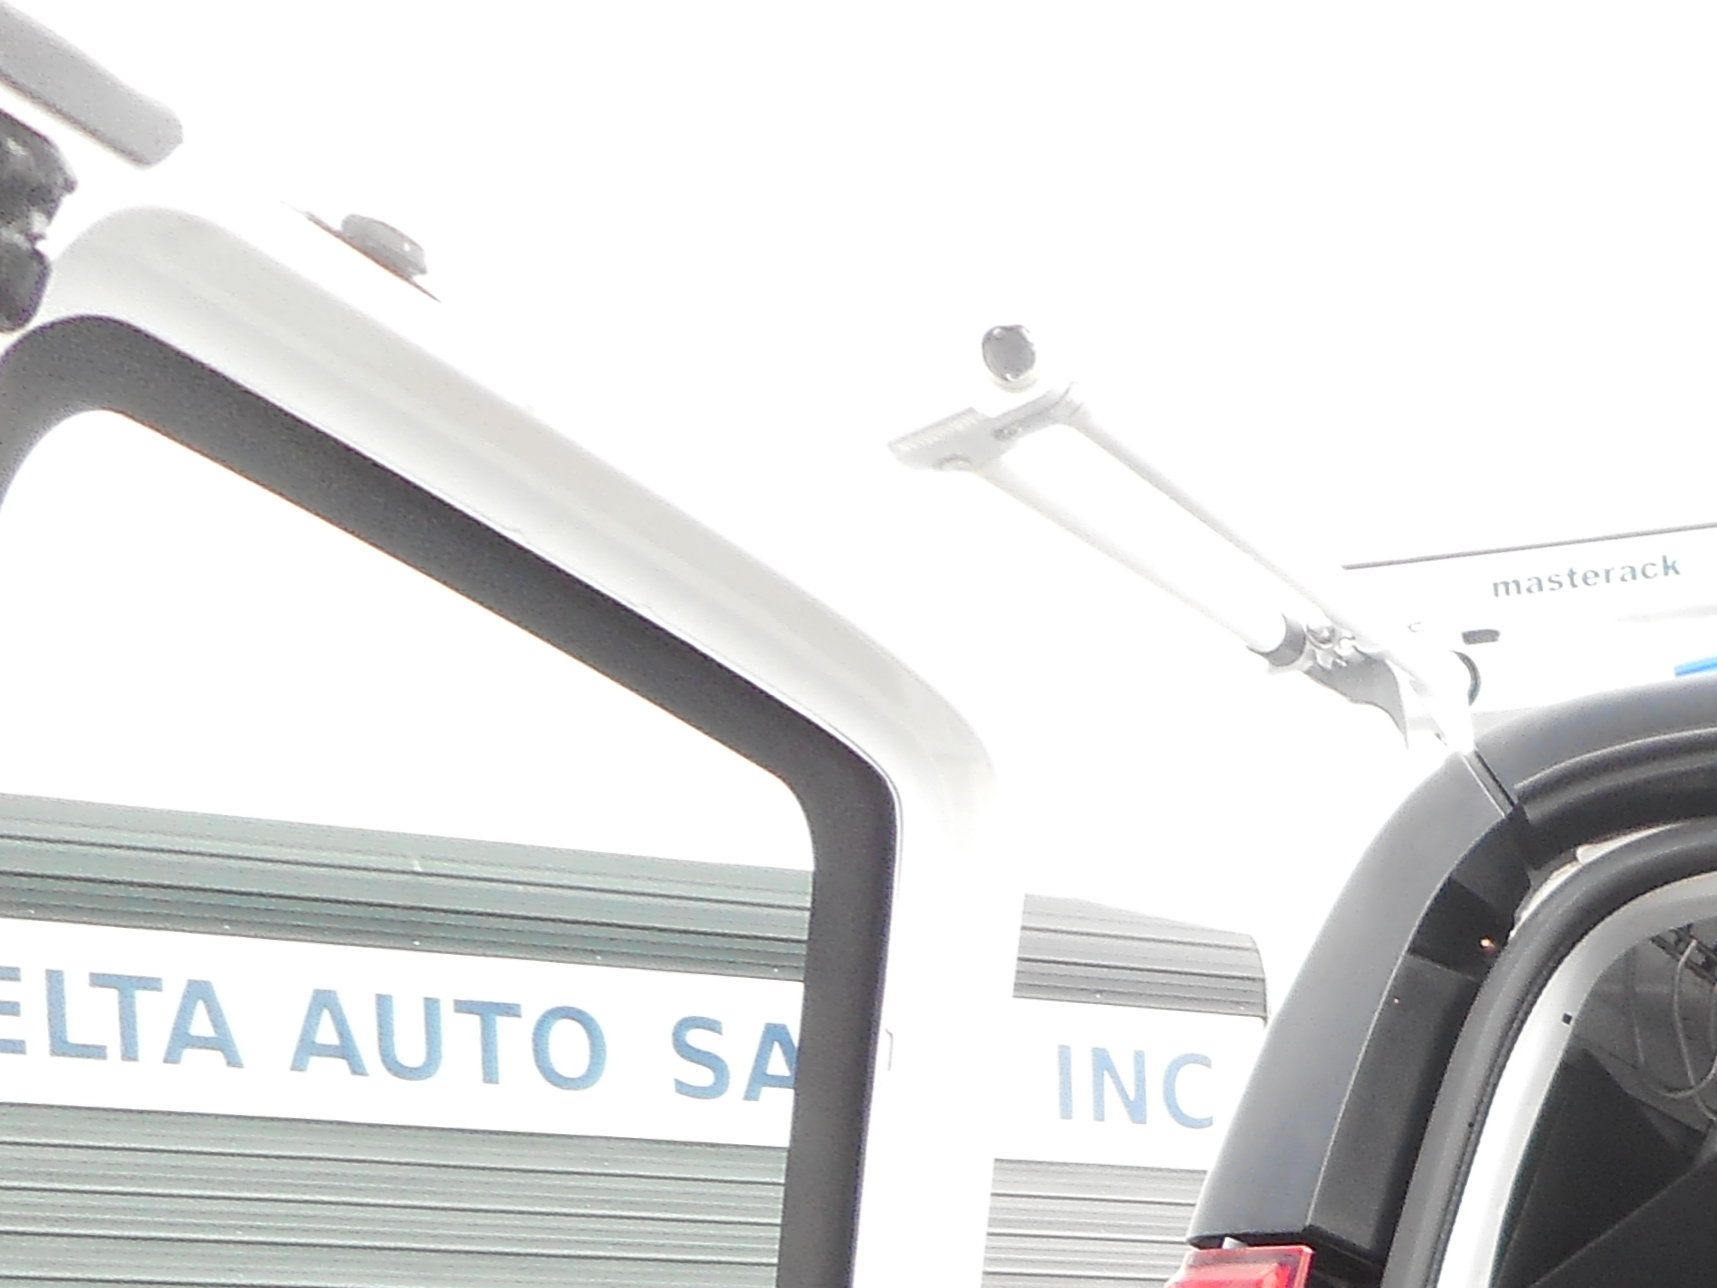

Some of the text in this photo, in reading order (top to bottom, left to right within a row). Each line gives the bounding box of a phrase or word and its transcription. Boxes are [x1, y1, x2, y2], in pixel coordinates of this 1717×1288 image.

[1492, 554, 1682, 598] masterack
[289, 987, 608, 1092] AUTO
[1056, 1043, 1215, 1130] INC
